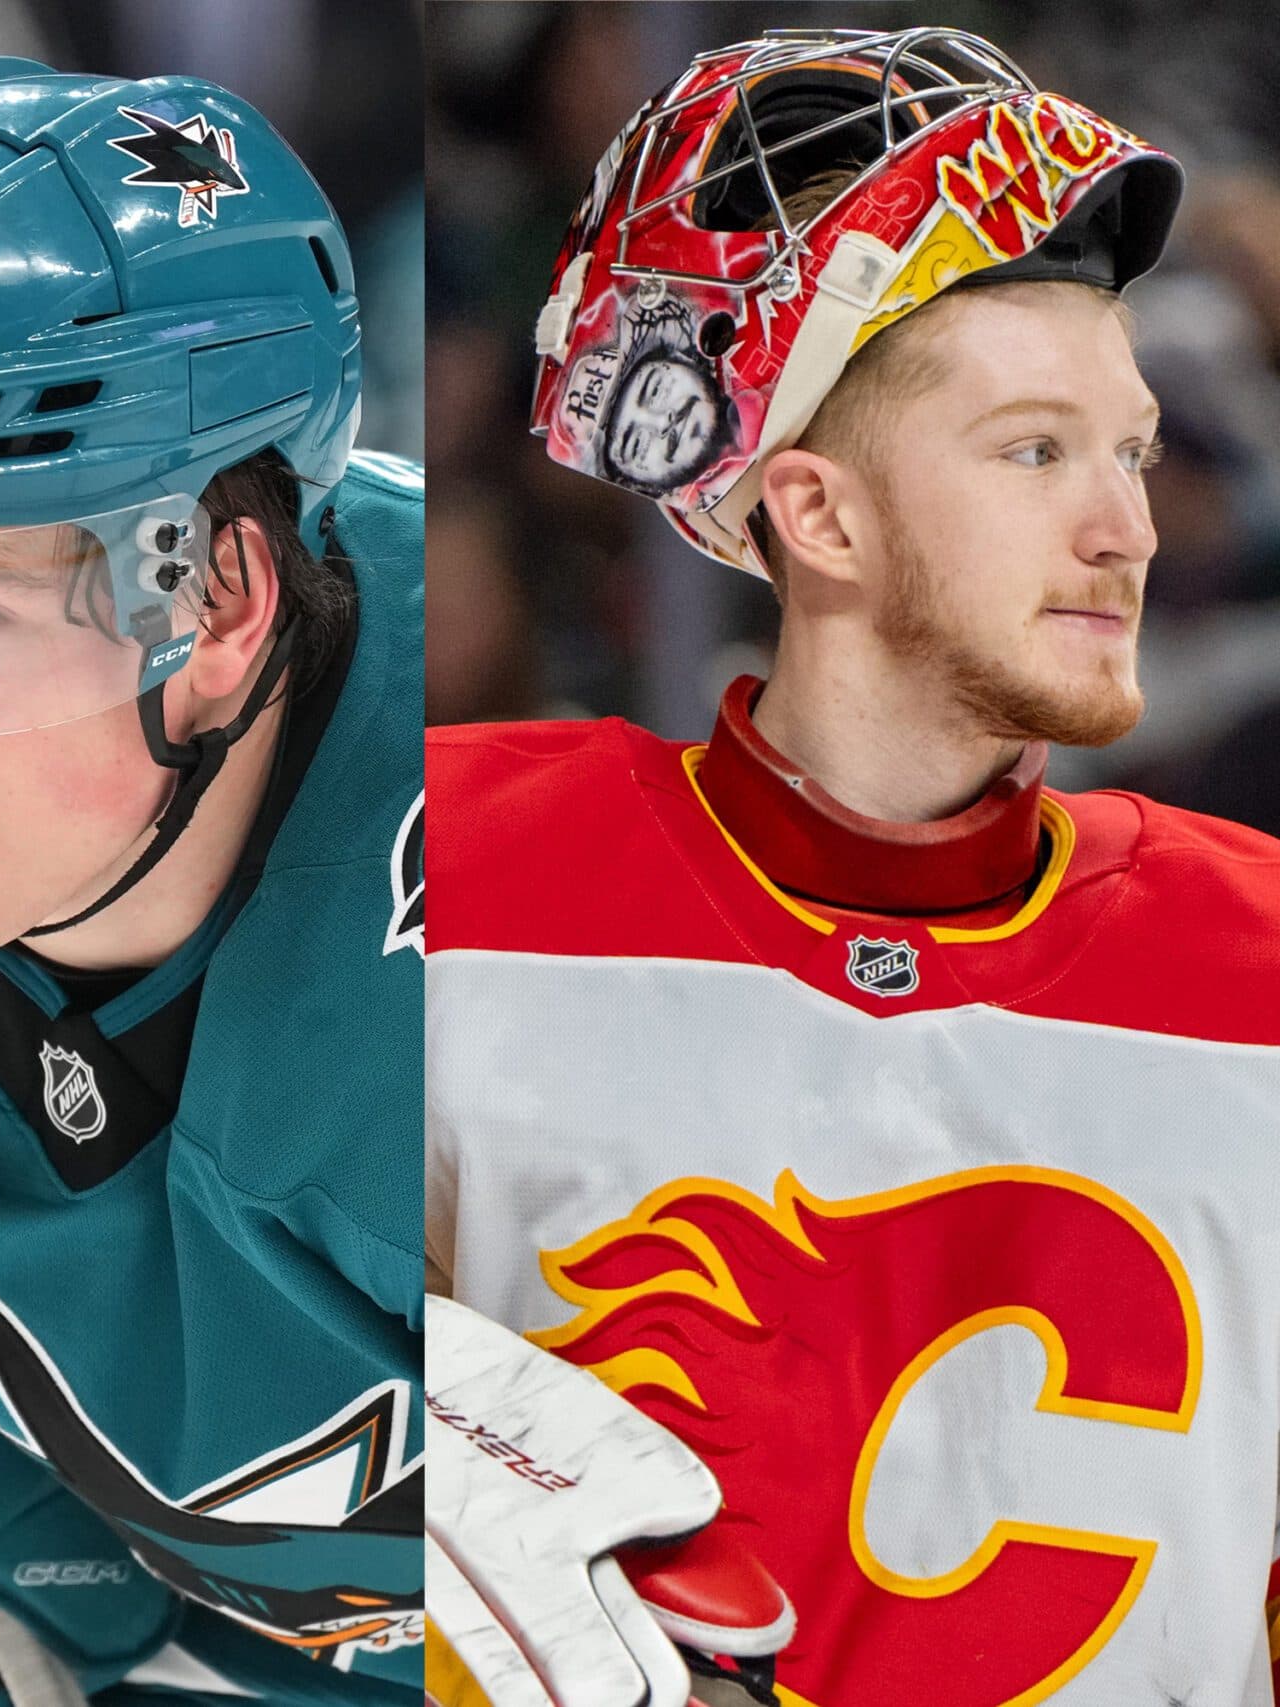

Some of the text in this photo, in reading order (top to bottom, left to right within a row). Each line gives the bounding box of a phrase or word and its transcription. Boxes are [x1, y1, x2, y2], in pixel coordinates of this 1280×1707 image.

[151, 641, 193, 668] CCM
[862, 955, 905, 983] NHL
[58, 1071, 89, 1117] NHL
[12, 1560, 130, 1587] CCM
